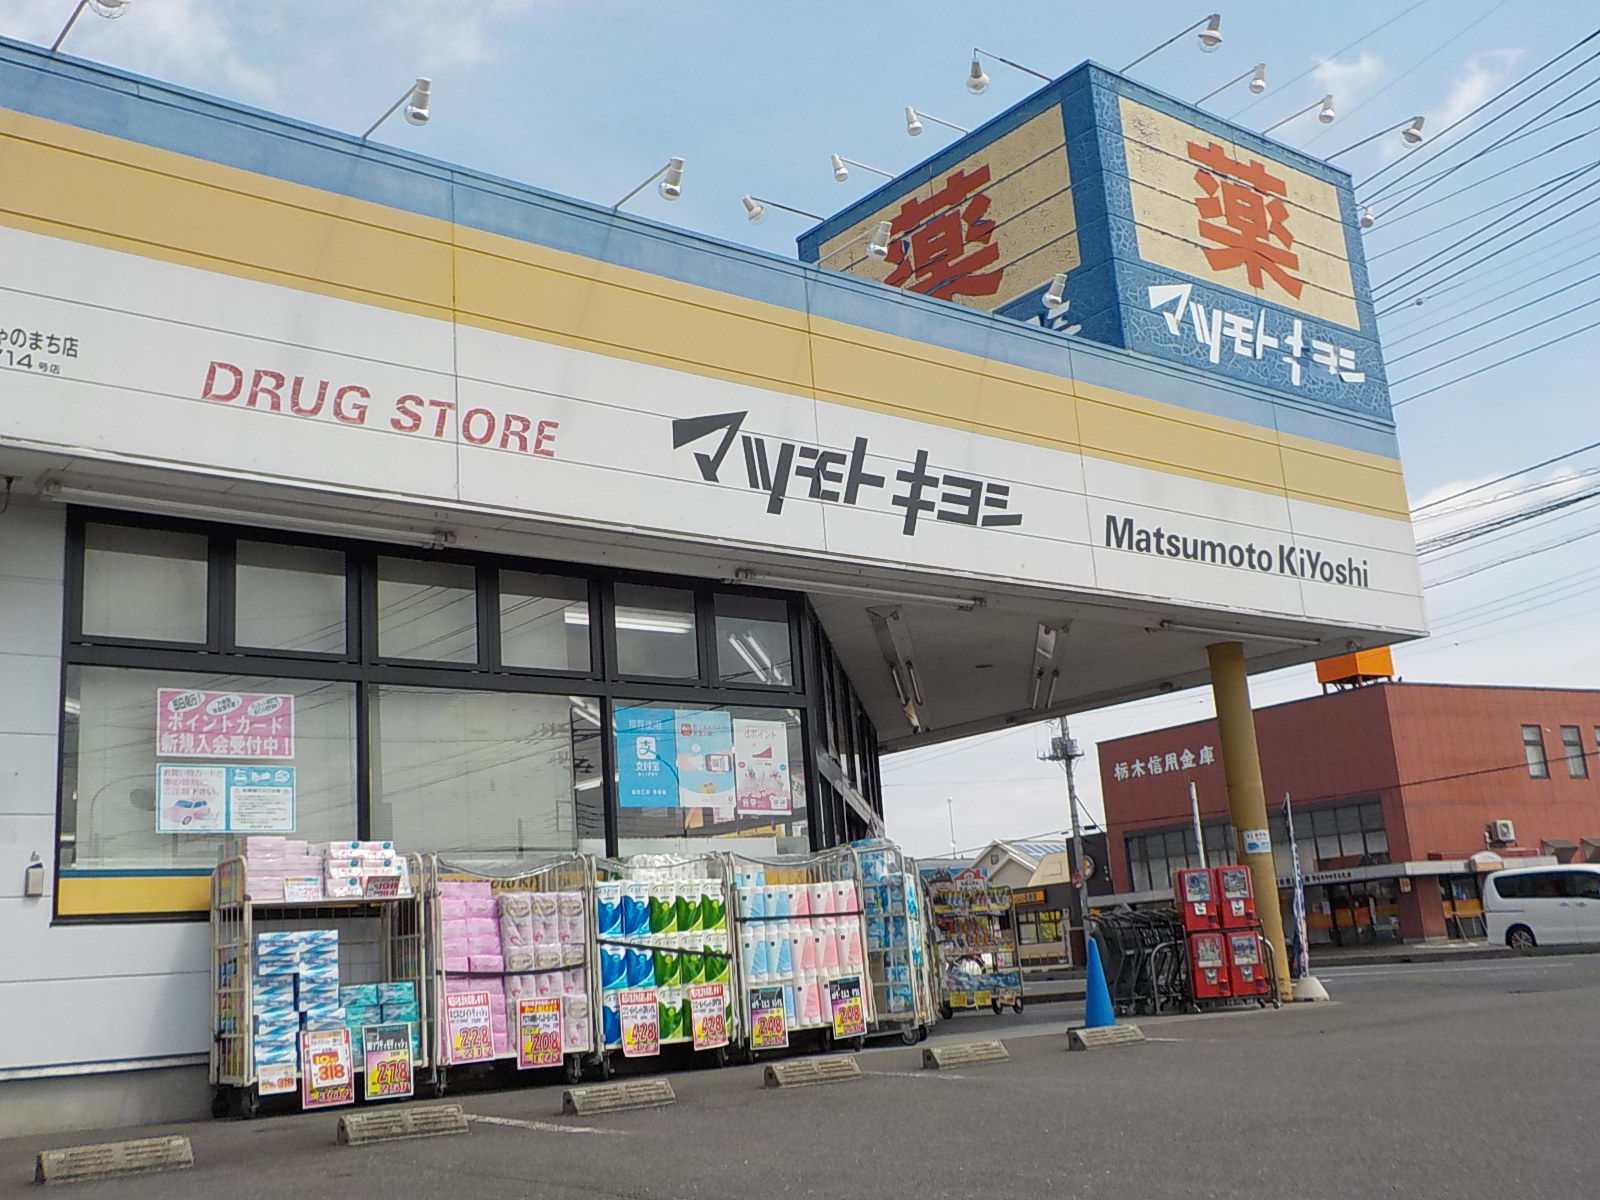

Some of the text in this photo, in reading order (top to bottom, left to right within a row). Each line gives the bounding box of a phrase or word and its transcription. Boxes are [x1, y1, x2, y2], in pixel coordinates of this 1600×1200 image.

[884, 163, 1004, 301] 薬
[1187, 140, 1305, 300] 薬
[1148, 283, 1366, 387] マツモトキヨシ
[201, 360, 561, 458] DRUG STORE
[671, 410, 1023, 537] マツモトキヨシ
[1104, 513, 1370, 589] Matsumoto KiYoshi
[167, 712, 284, 736] ポイントカード
[1113, 744, 1216, 782] 栃木信用金庫
[759, 1017, 783, 1036] 248
[838, 1006, 861, 1024] 248
[461, 1027, 491, 1048] 228
[532, 1032, 560, 1053] 208
[631, 1024, 656, 1041] 428
[318, 1063, 346, 1081] 318
[377, 1061, 408, 1084] 278
